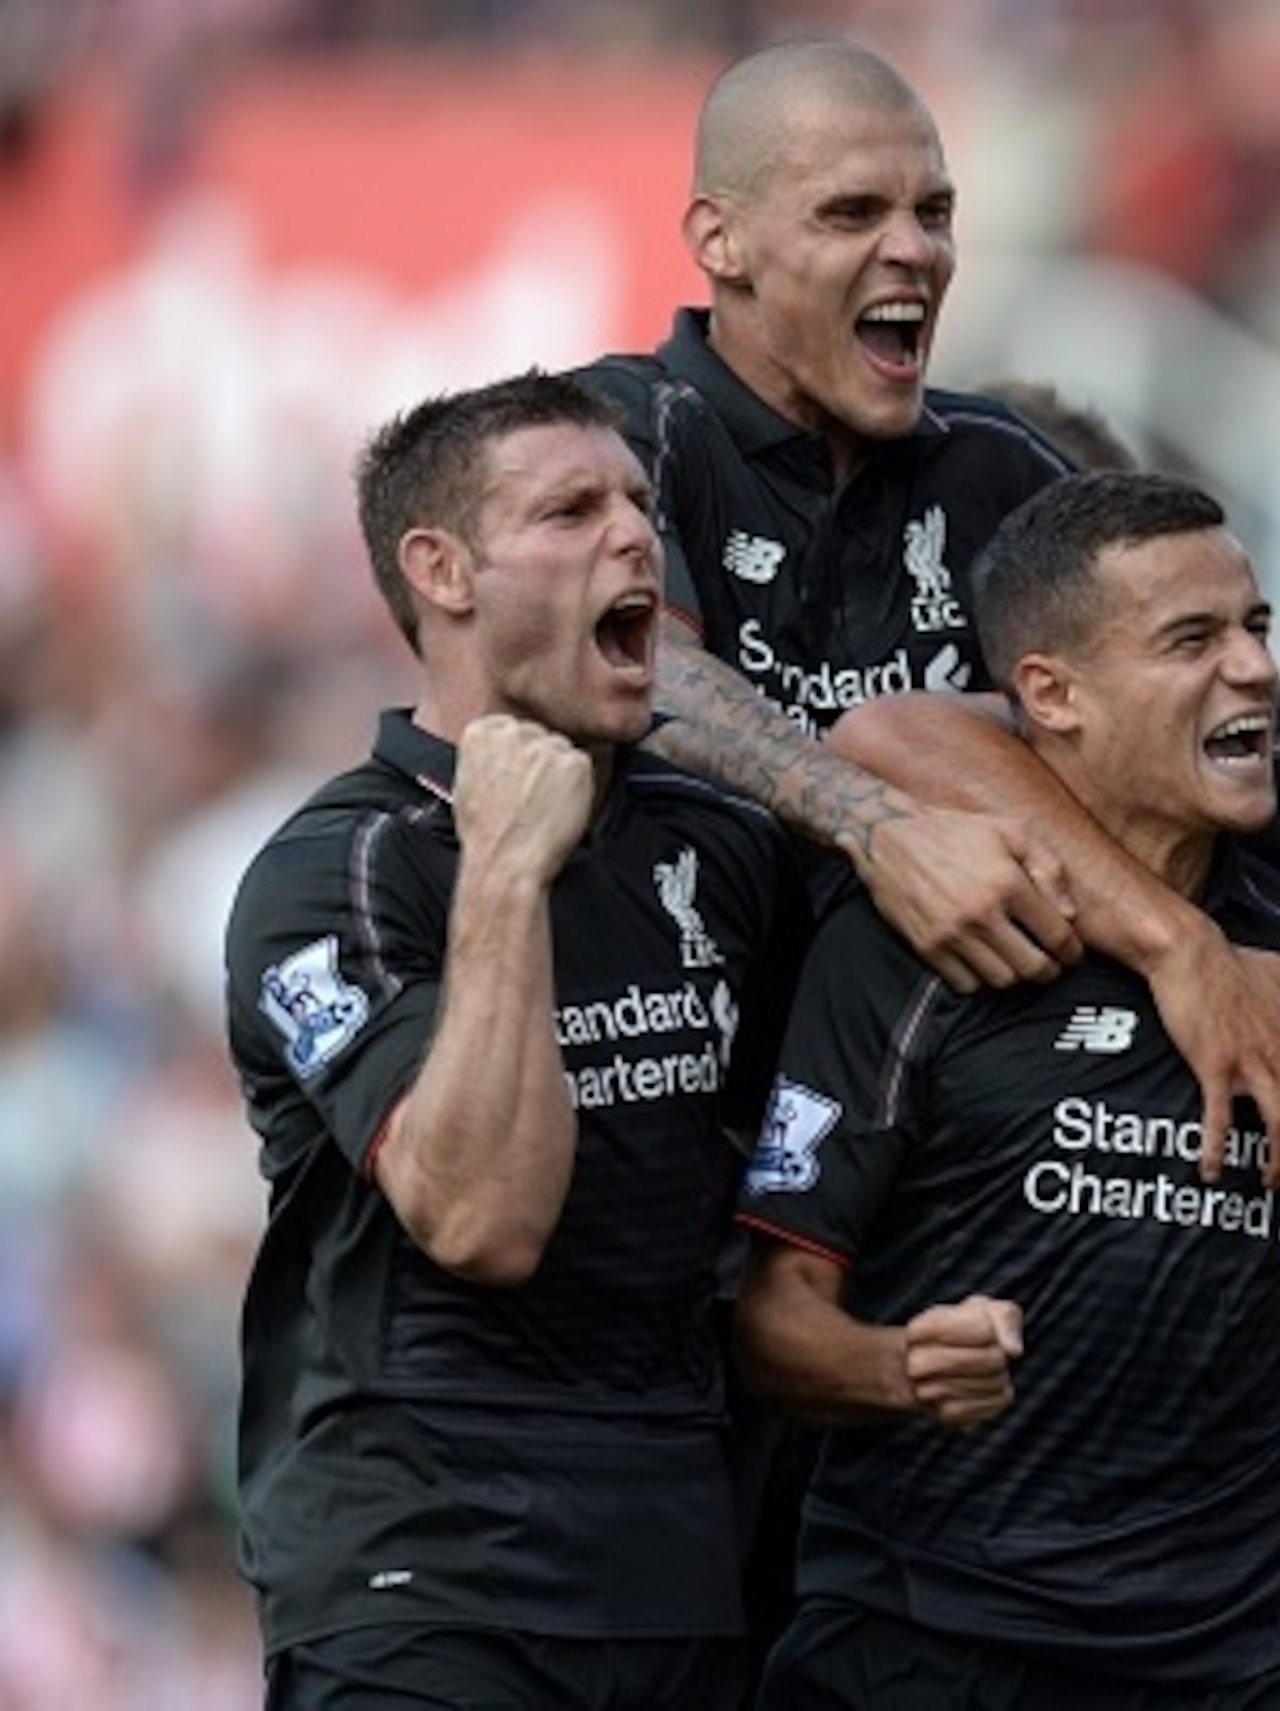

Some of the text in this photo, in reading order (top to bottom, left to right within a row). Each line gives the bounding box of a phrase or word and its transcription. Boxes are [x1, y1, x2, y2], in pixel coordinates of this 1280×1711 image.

[738, 617, 912, 709] Sndard
[552, 981, 711, 1046] tandard
[1053, 1006, 1138, 1053] NB
[563, 1040, 718, 1110] artered
[1023, 1160, 1274, 1238] Chartered
